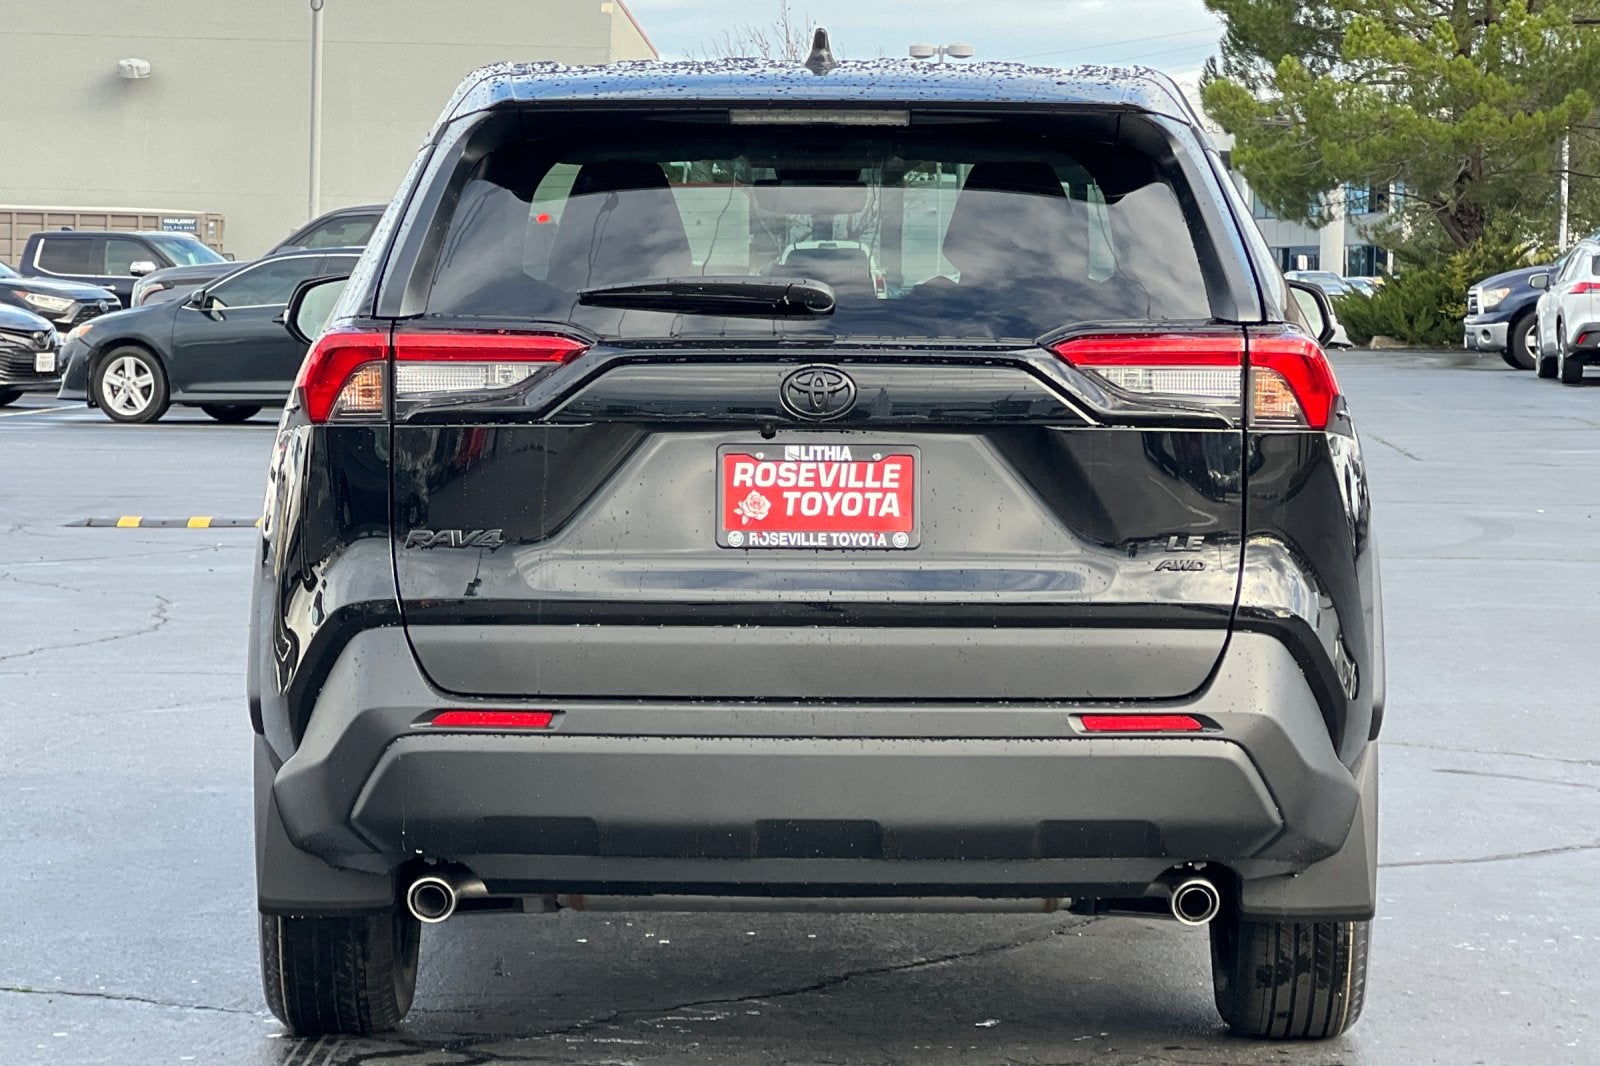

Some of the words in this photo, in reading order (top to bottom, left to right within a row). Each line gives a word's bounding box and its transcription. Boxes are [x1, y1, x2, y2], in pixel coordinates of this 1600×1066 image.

[801, 446, 852, 461] LITHIA
[733, 462, 901, 488] ROSEVILLE
[783, 491, 900, 517] TOYOTA
[405, 529, 503, 550] RAV4
[749, 532, 827, 546] ROSEVILLE
[830, 532, 887, 546] TOYOTA
[1165, 535, 1205, 552] LE
[1155, 559, 1207, 572] AWD
